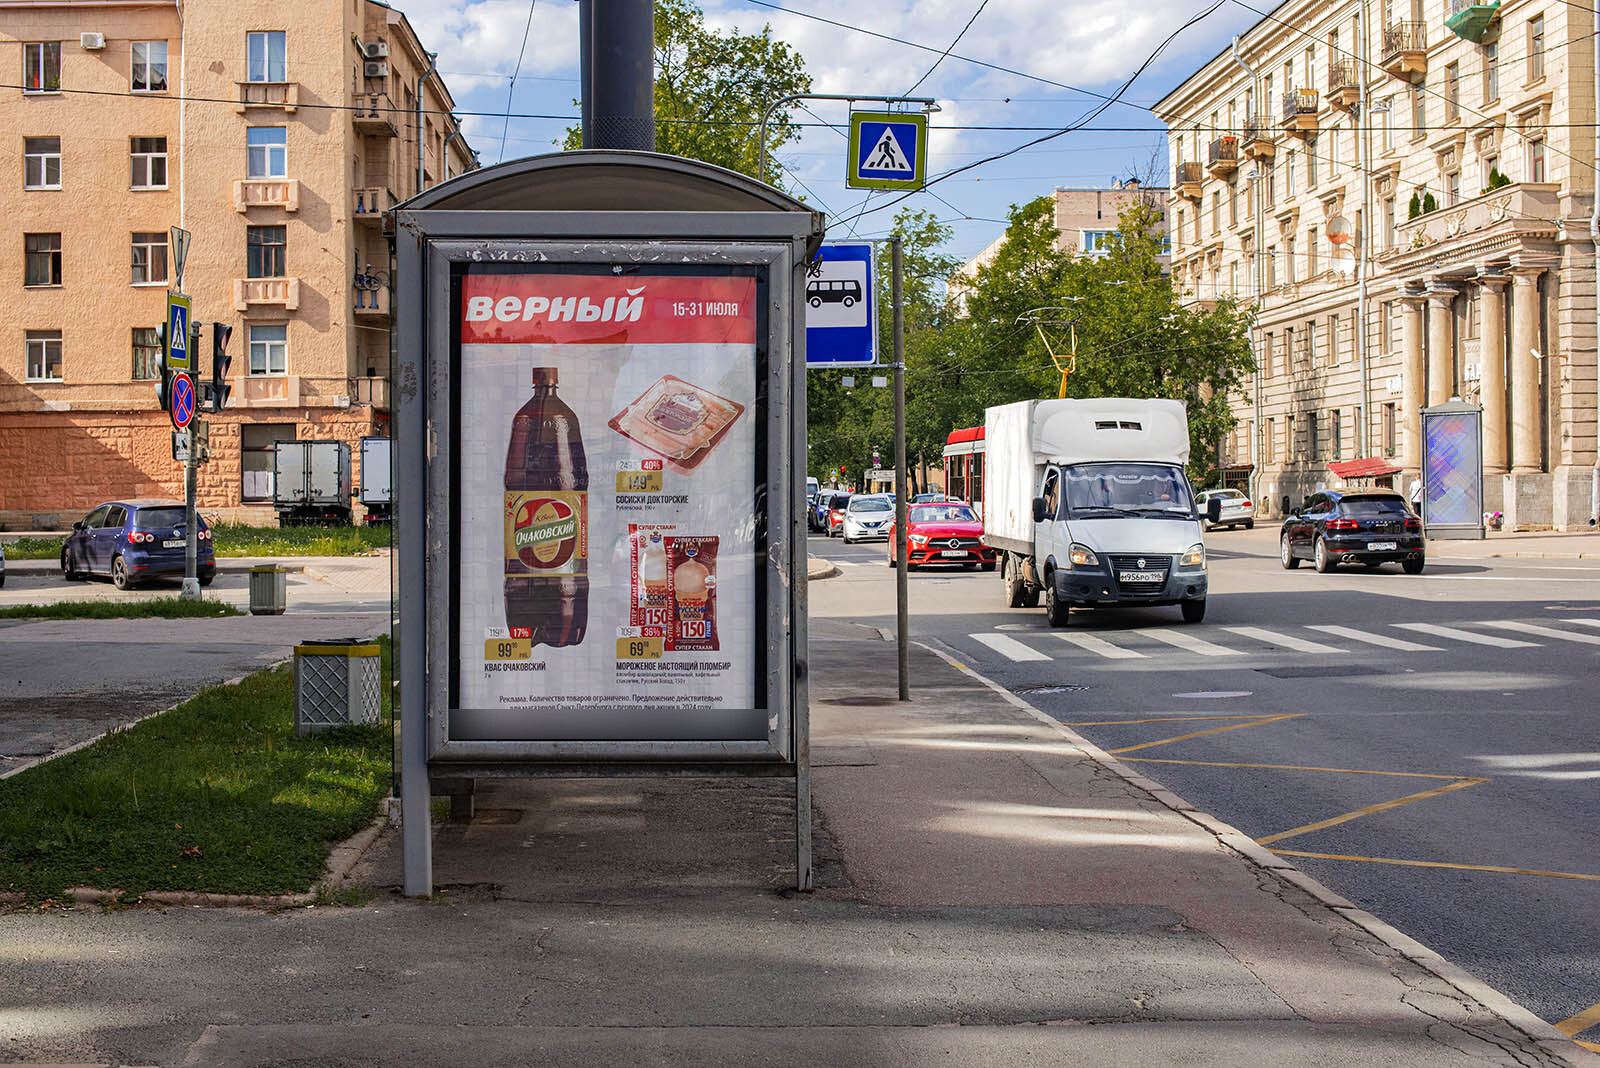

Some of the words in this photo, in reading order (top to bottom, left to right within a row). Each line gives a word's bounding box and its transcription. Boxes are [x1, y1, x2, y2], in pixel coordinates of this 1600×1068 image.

[672, 302, 703, 317] 15-31
[705, 302, 739, 317] ИЮЛЯ
[643, 460, 661, 470] 40%
[628, 475, 647, 490] 149
[616, 495, 646, 504] СОСИСКИ
[646, 495, 689, 504] ДОКТОРСКИЕ
[647, 609, 667, 625] 150
[513, 628, 529, 638] 17%
[644, 627, 661, 636] 36%
[683, 622, 705, 637] 150
[498, 643, 512, 658] 99
[630, 641, 643, 656] 69
[484, 663, 503, 671] КВАС
[503, 661, 546, 671] ОЧАКОВСКИЙ
[616, 662, 656, 671] МОРОЖЕНОЕ
[657, 661, 698, 671] НАСТОЯЩИЙ
[699, 662, 731, 671] ПЛОМБИР
[632, 694, 675, 703] Предложение
[676, 694, 723, 703] действительно
